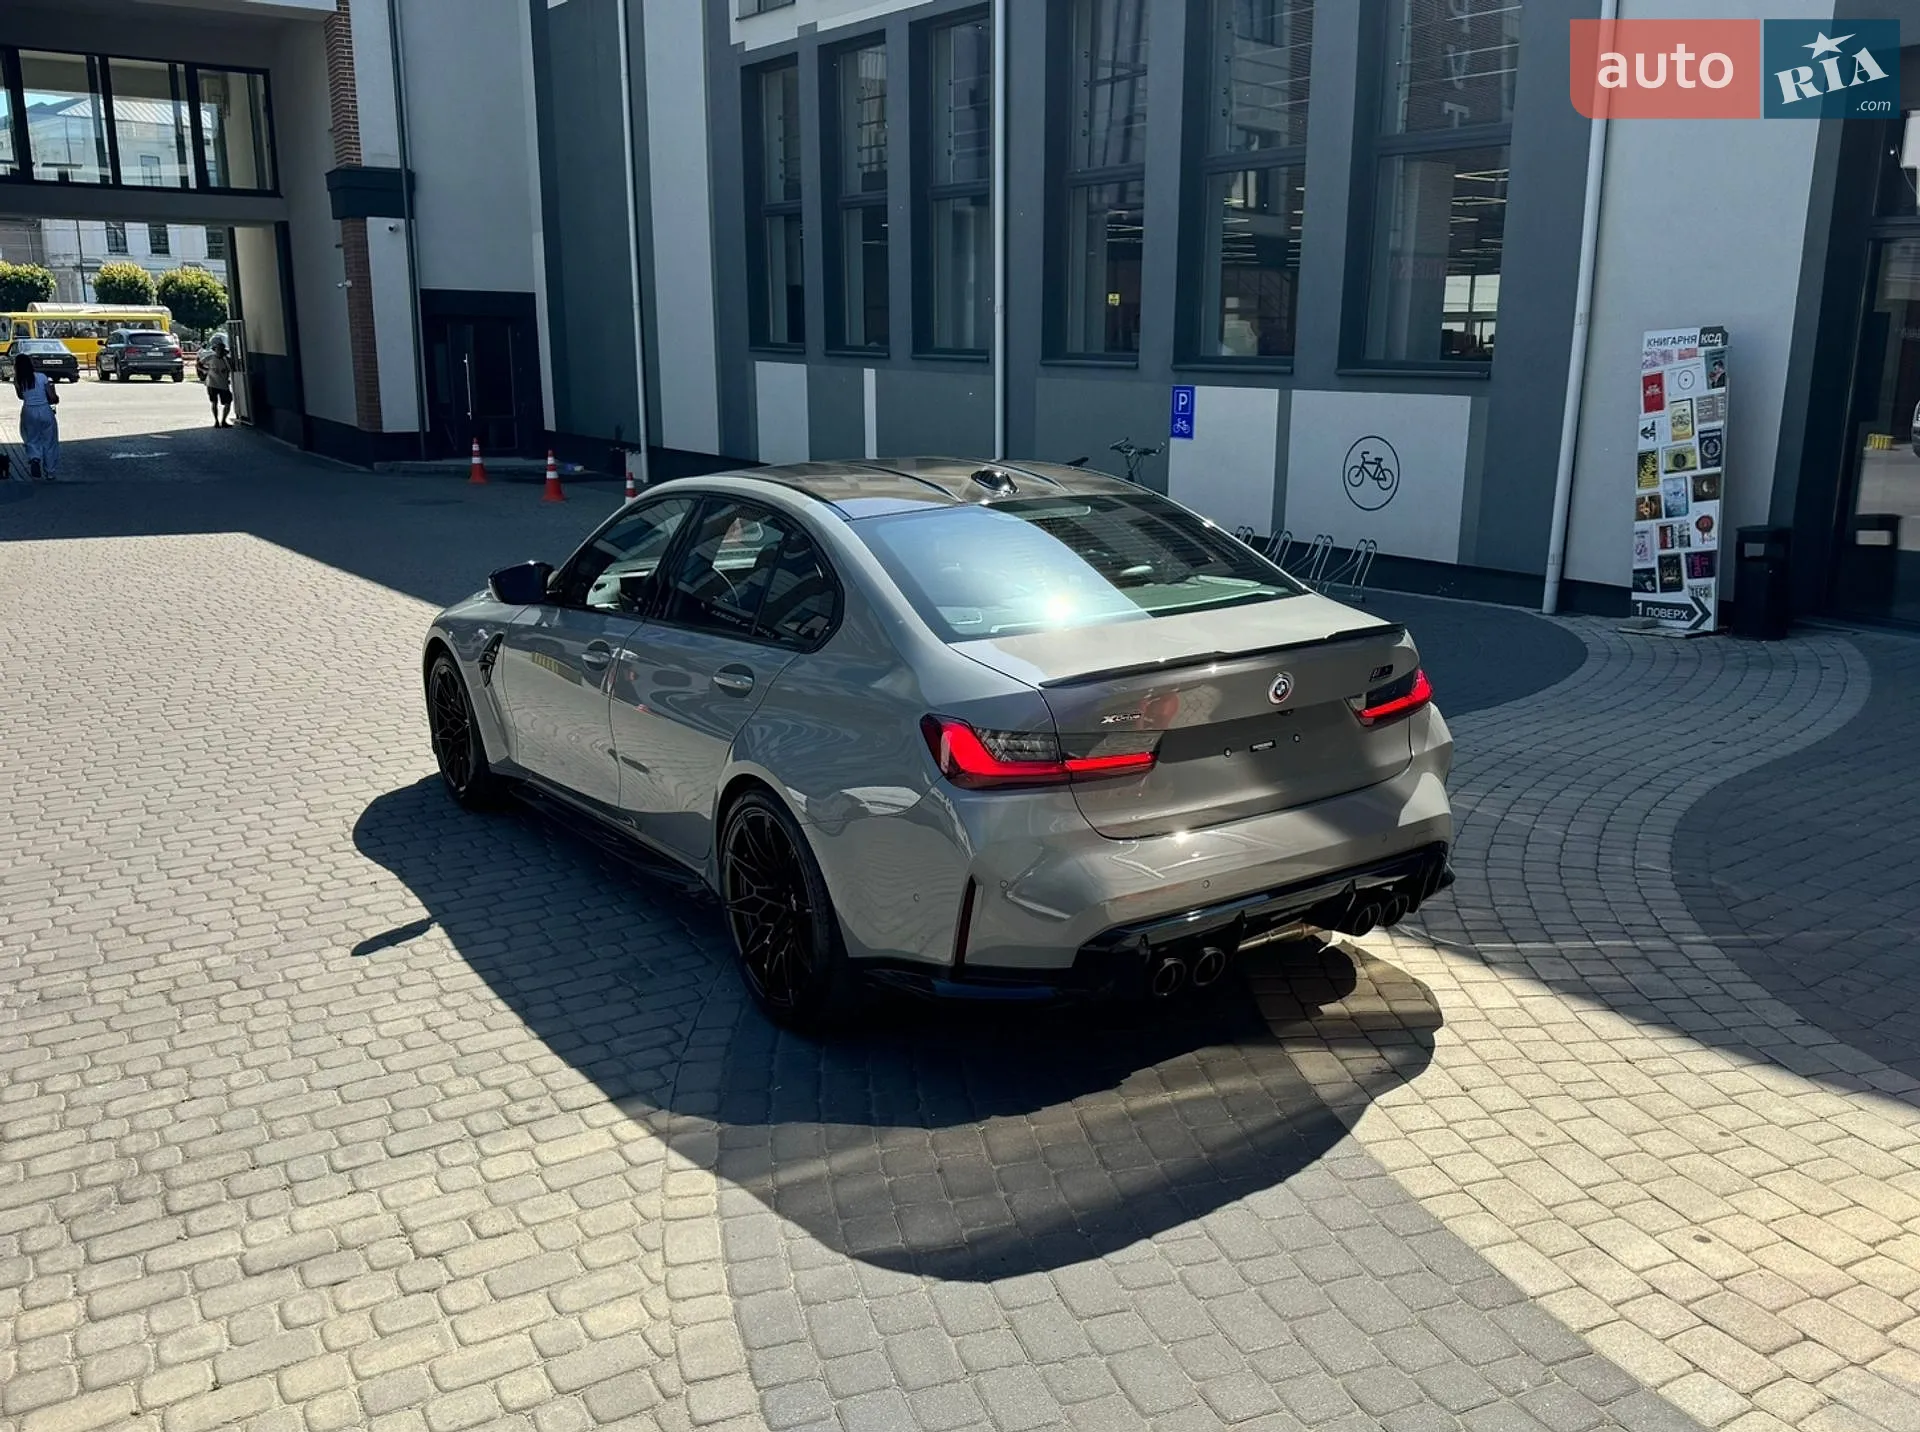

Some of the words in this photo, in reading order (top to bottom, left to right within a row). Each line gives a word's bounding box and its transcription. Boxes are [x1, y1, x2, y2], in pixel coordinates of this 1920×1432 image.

[1647, 334, 1697, 347] КНИГАРНЯ
[1178, 392, 1188, 412] P
[1636, 602, 1643, 616] 1
[1646, 606, 1688, 620] ПОВЕРХ
